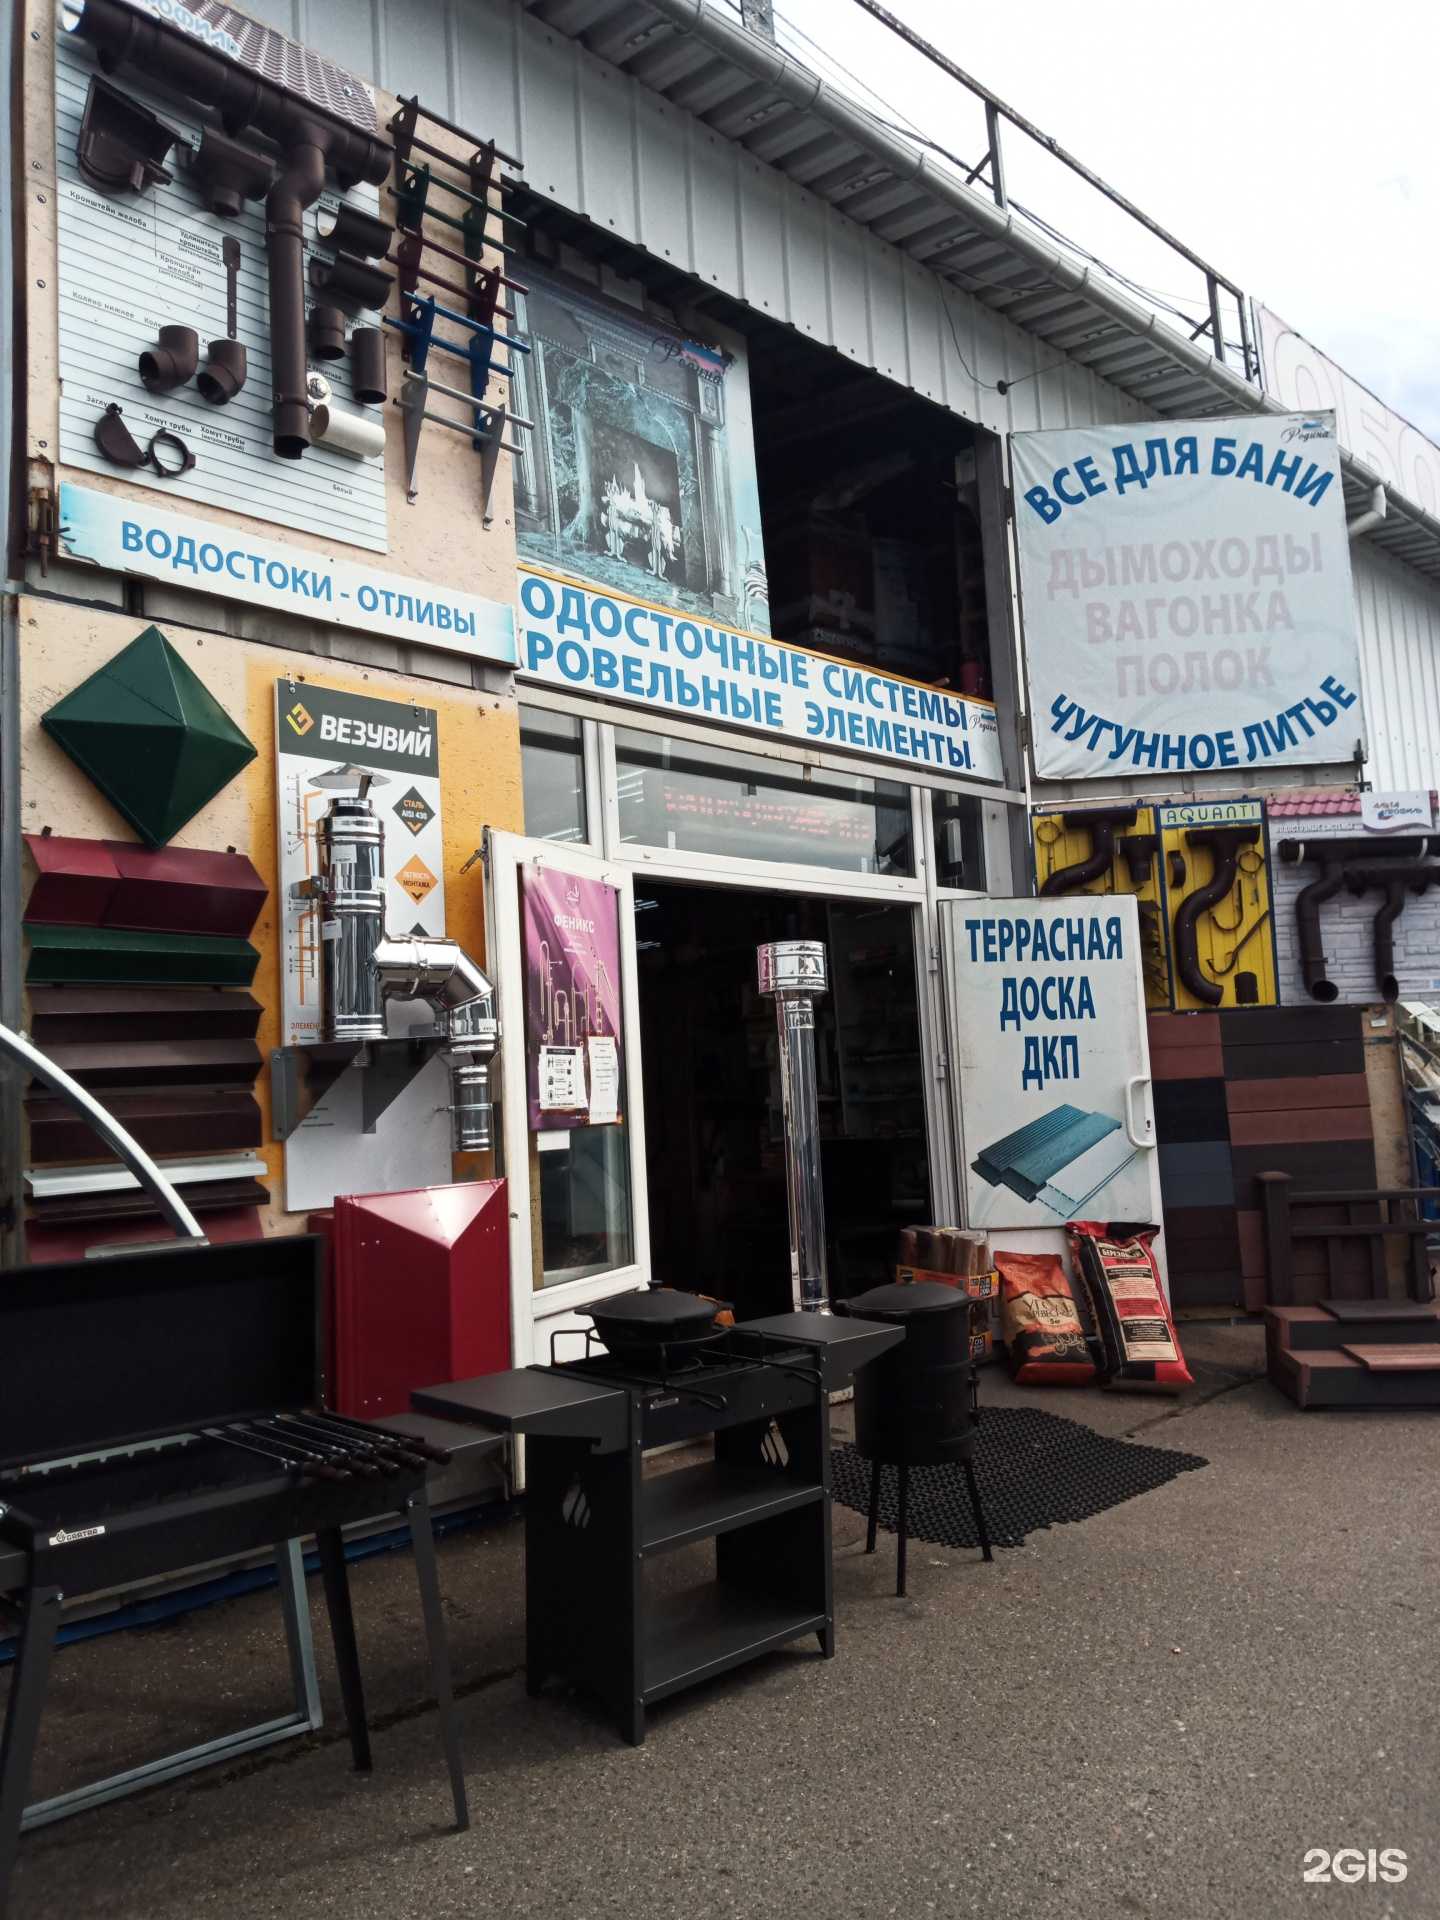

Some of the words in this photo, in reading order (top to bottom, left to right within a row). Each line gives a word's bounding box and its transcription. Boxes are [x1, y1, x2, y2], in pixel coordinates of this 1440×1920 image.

[144, 0, 239, 54] ОФИЛЬ
[86, 394, 110, 408] Заглу
[144, 412, 168, 426] Хомут
[169, 421, 192, 433] трубы
[200, 424, 223, 438] Хомут
[1024, 455, 1107, 525] ВСЕ
[1111, 436, 1199, 495] ДЛЯ
[1211, 437, 1334, 507] БАНИ
[121, 520, 333, 602] ВОДОСТОКИ
[339, 591, 350, 600] -
[357, 584, 477, 637] ОТЛИВЫ
[1046, 532, 1323, 601] ДЫМОХОДЫ
[1085, 590, 1294, 645] ВАГОНКА
[520, 577, 810, 690] ОДОСТОЧНЫЕ
[822, 663, 969, 731] СИСТЕМЫ
[520, 630, 783, 728] РОВЕЛЬНЫЕ
[1116, 646, 1276, 700] ПОЛОК
[320, 714, 432, 759] ВЕЗУВИЙ
[1049, 694, 1239, 770] ЧУГУННОЕ
[1245, 675, 1357, 763] ЛИТЬЕ
[403, 799, 425, 810] СТАЛЬ
[1167, 804, 1255, 823] AQUANTI
[553, 913, 595, 934] ФЕНИКС
[965, 915, 1124, 963] ТЕРРАСНАЯ
[999, 975, 1097, 1032] ДОСКА
[1021, 1034, 1081, 1092] ДКП
